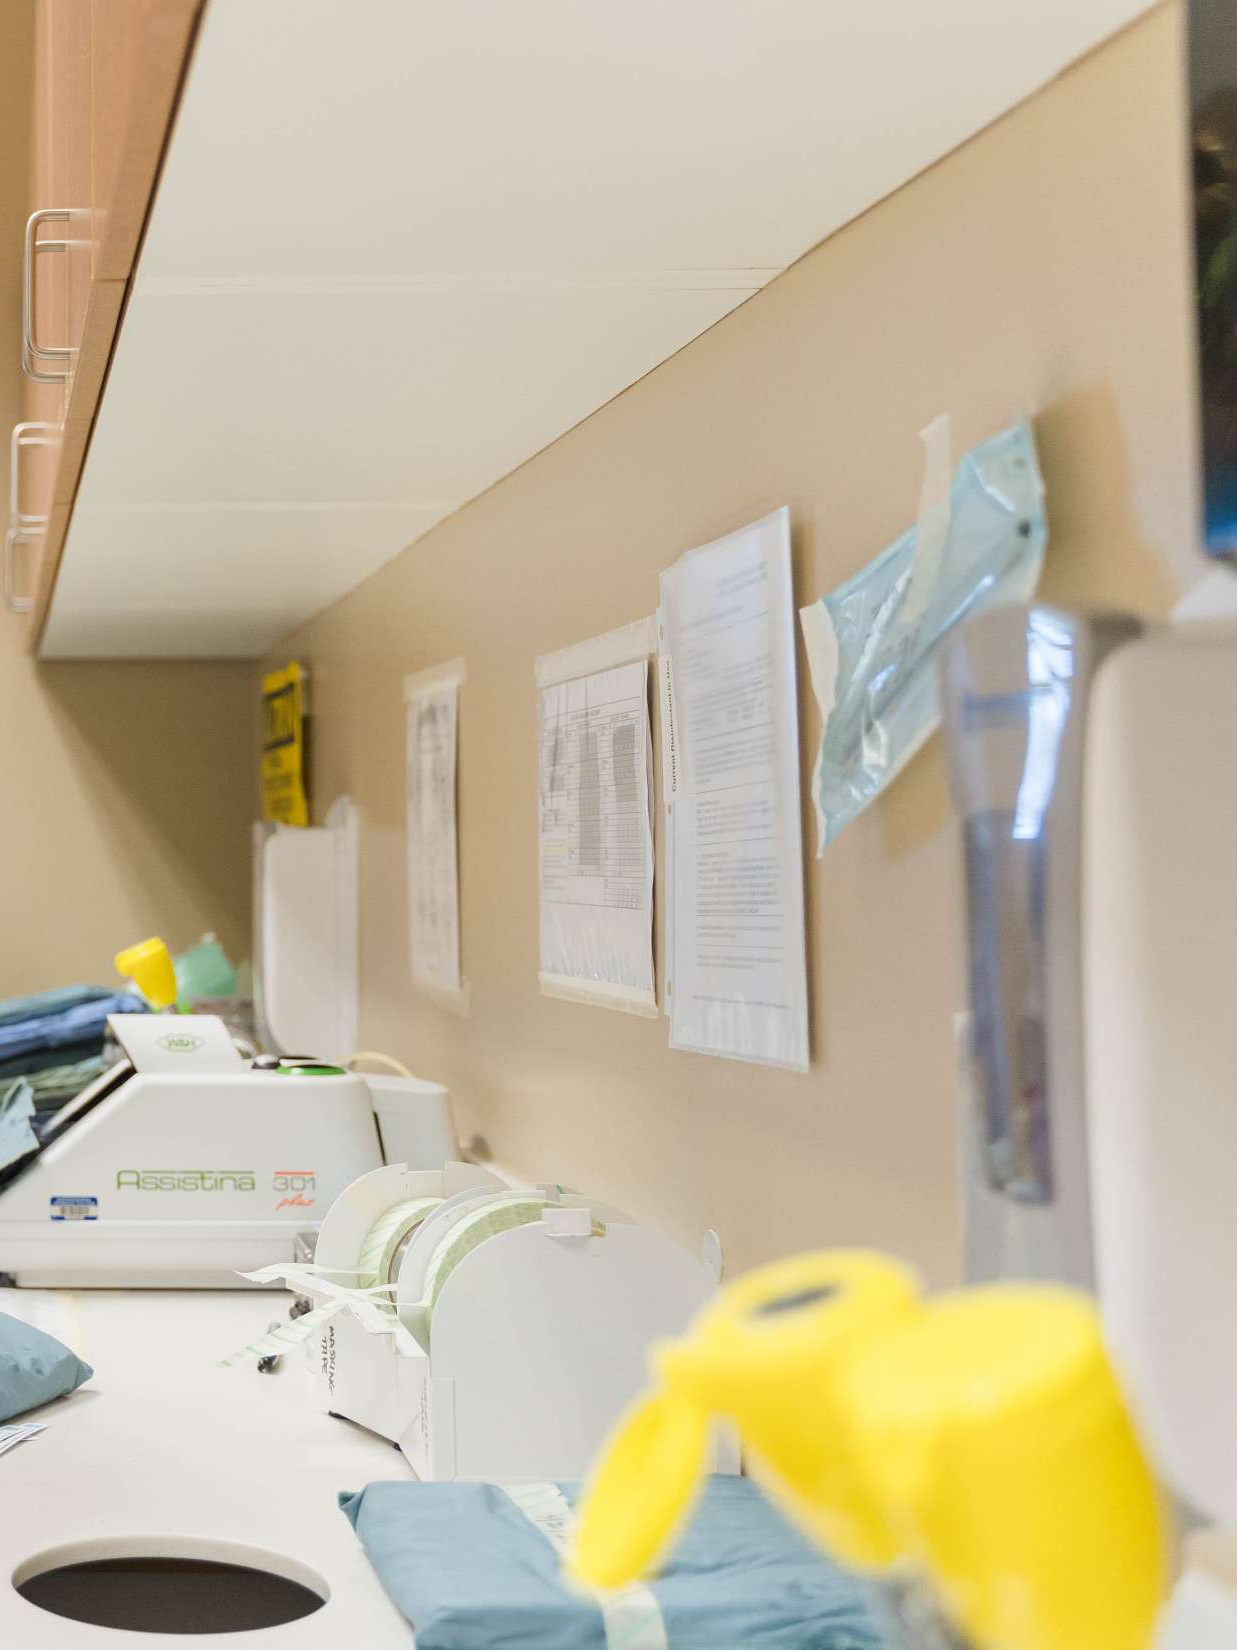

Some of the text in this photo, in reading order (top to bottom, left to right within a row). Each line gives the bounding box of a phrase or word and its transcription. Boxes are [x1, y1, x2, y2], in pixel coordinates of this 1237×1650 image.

[116, 1170, 316, 1192] Assistina 301
[328, 1325, 336, 1394] MASKING
